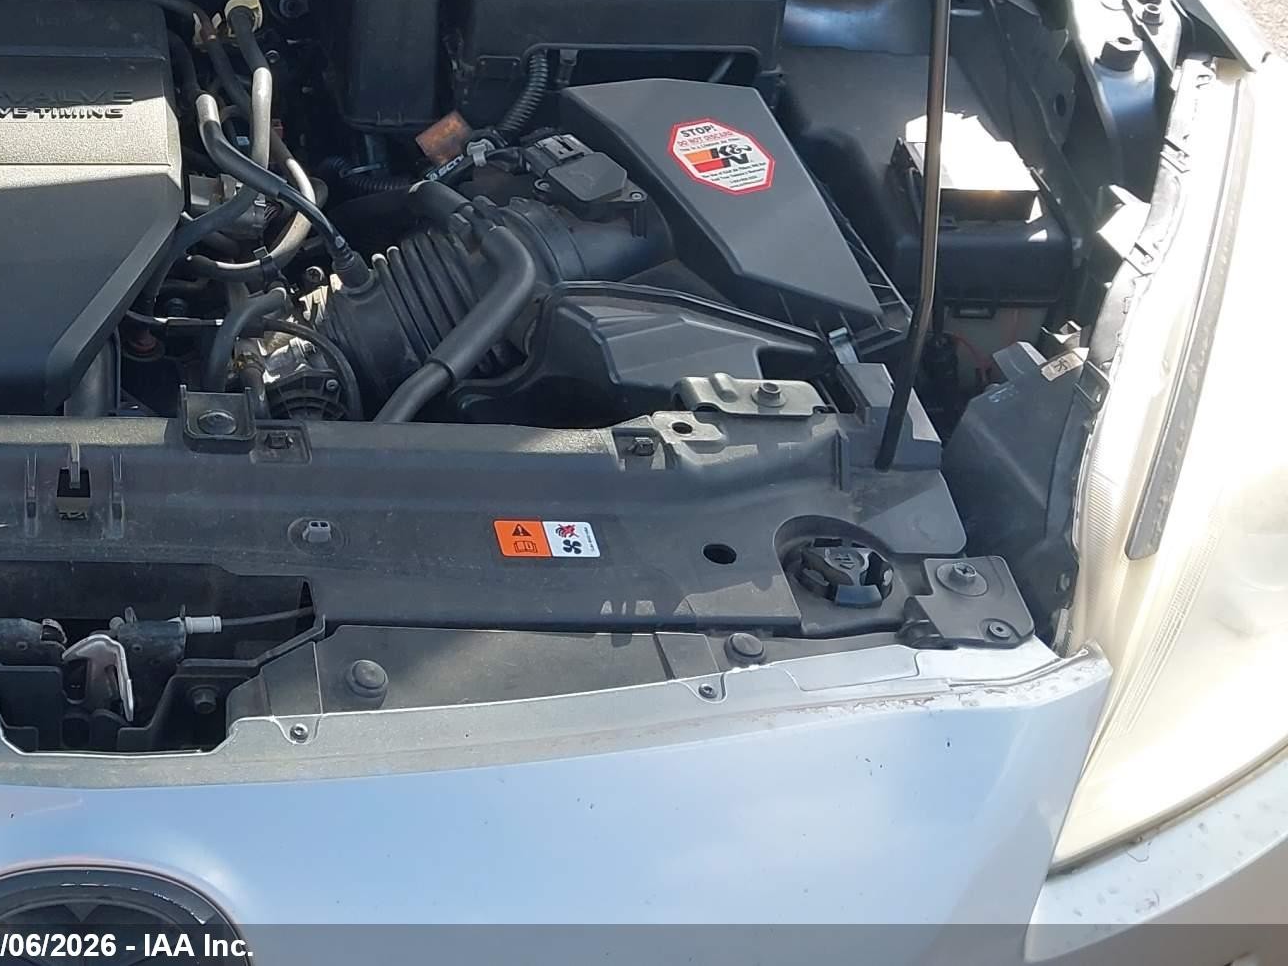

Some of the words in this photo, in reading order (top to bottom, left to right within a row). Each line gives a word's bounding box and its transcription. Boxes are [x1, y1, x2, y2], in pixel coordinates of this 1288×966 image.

[34, 106, 125, 120] TIMING
[680, 125, 716, 137] STOP!
[711, 143, 753, 168] K&N
